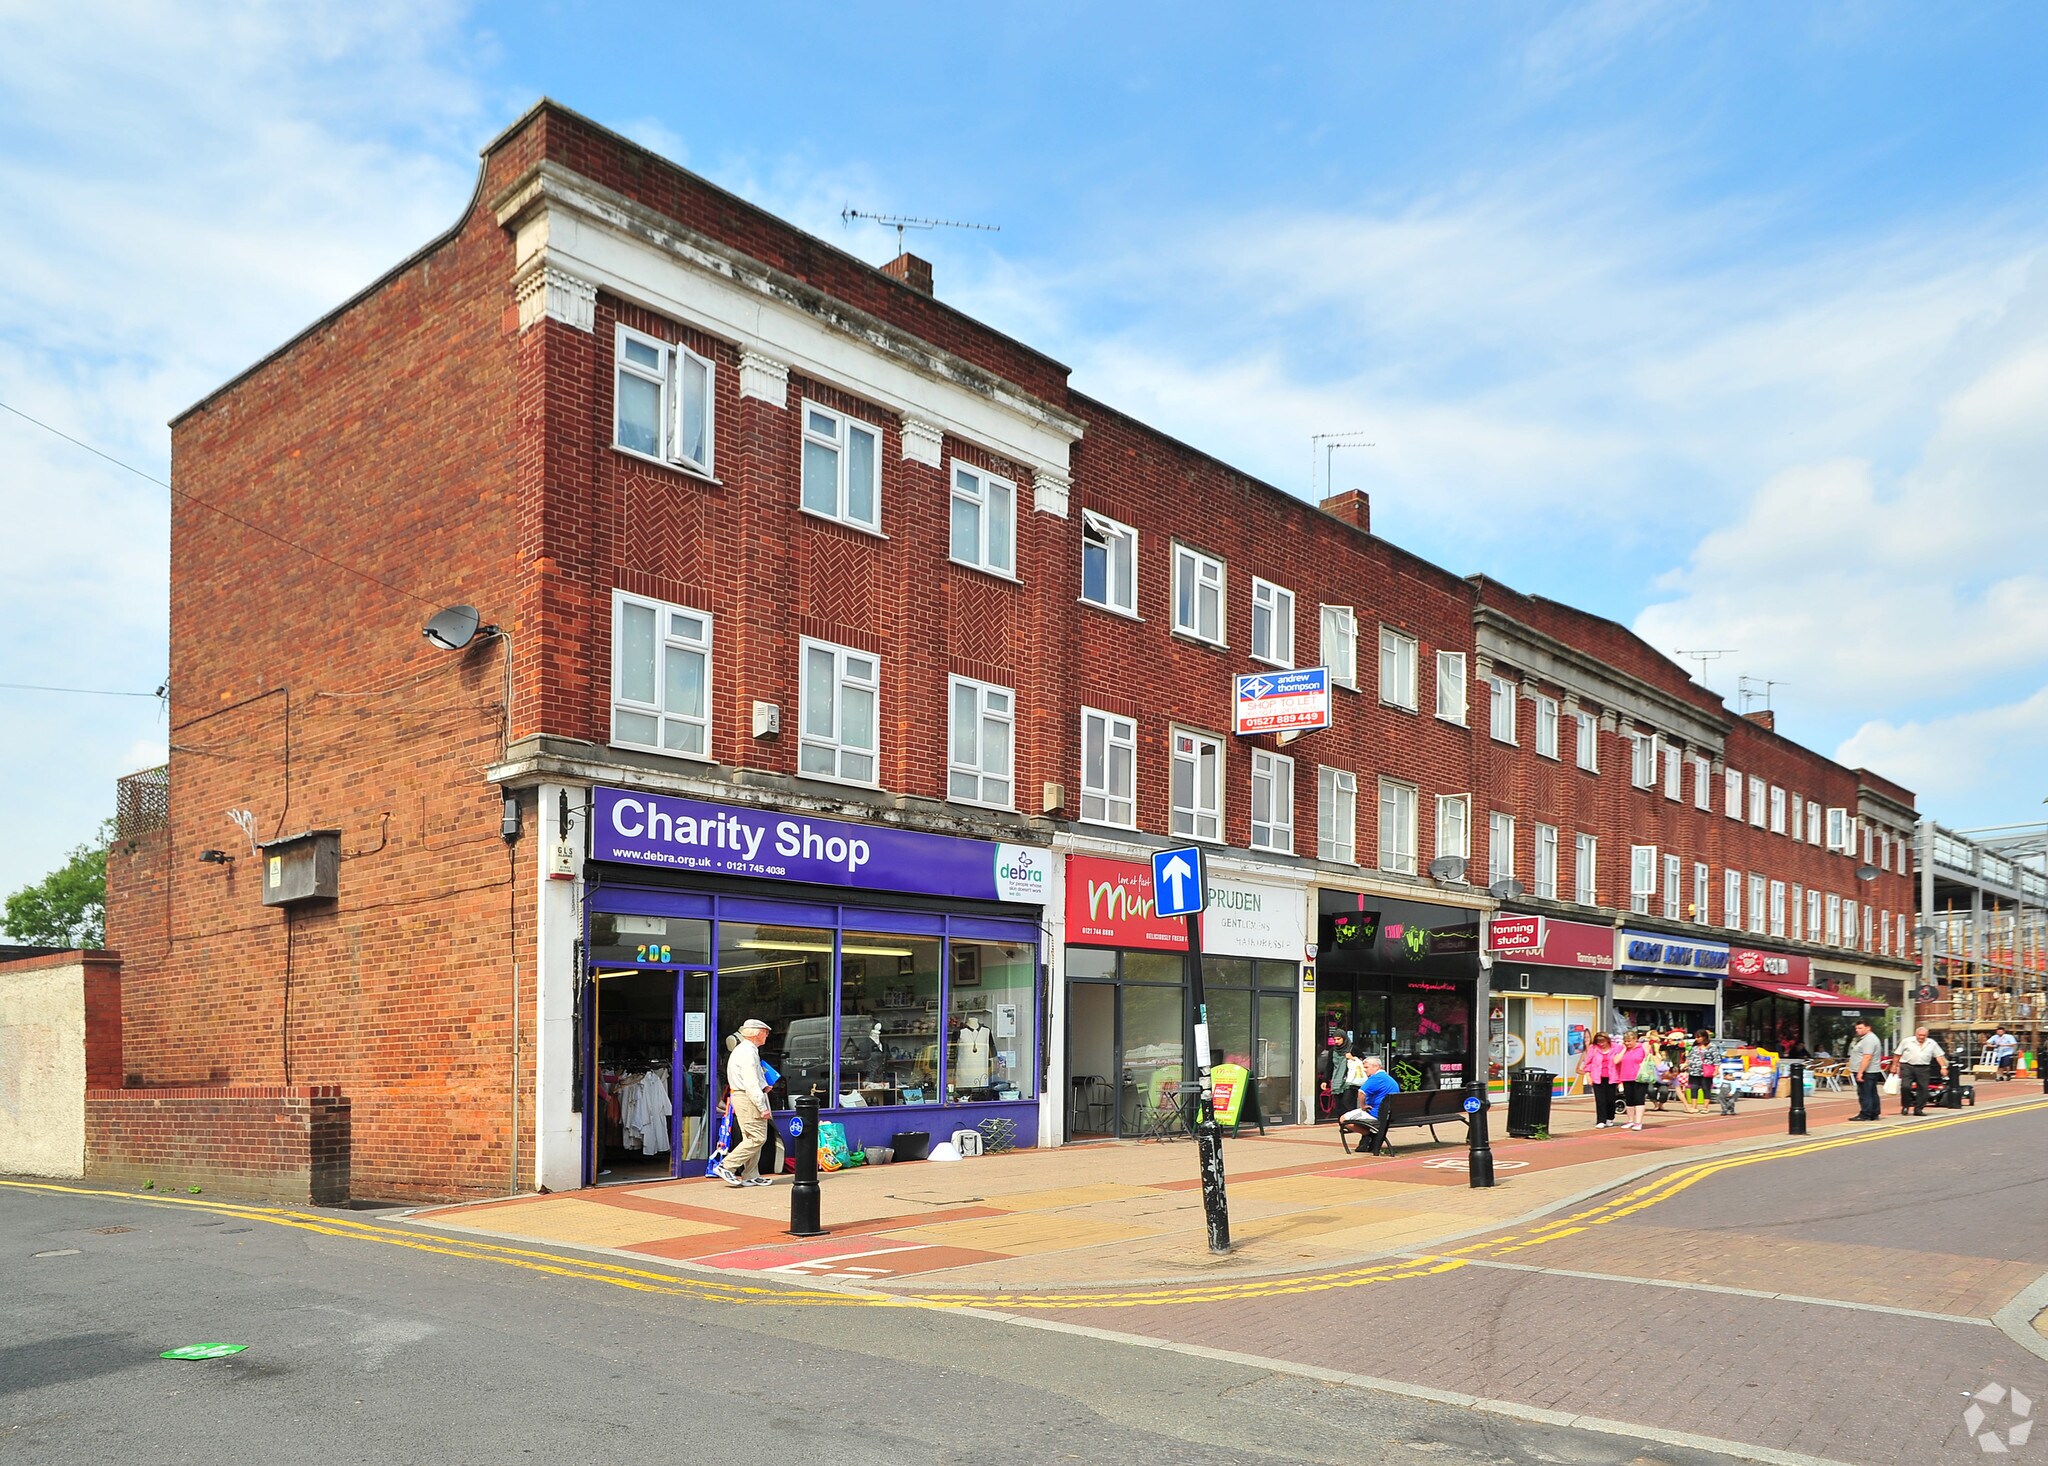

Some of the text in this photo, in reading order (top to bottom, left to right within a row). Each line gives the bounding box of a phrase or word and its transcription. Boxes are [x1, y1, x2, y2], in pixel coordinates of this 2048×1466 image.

[1278, 675, 1310, 684] andrew
[1278, 682, 1320, 693] thompson
[1248, 701, 1276, 711] SHOP
[1282, 699, 1294, 707] TO
[1298, 697, 1316, 706] LET
[1246, 717, 1275, 727] 01527
[1298, 712, 1318, 721] 449
[612, 799, 870, 873] Charity Shop
[558, 846, 573, 854] GLS
[612, 847, 711, 867] www.debra.org.uk
[726, 860, 786, 876] 0121 745 4038
[1000, 864, 1042, 882] debra
[1493, 923, 1534, 934] tanning
[1497, 934, 1530, 945] studio
[636, 944, 671, 963] 206
[1576, 952, 1613, 966] Tanning Studio
[1535, 1031, 1560, 1056] Sun
